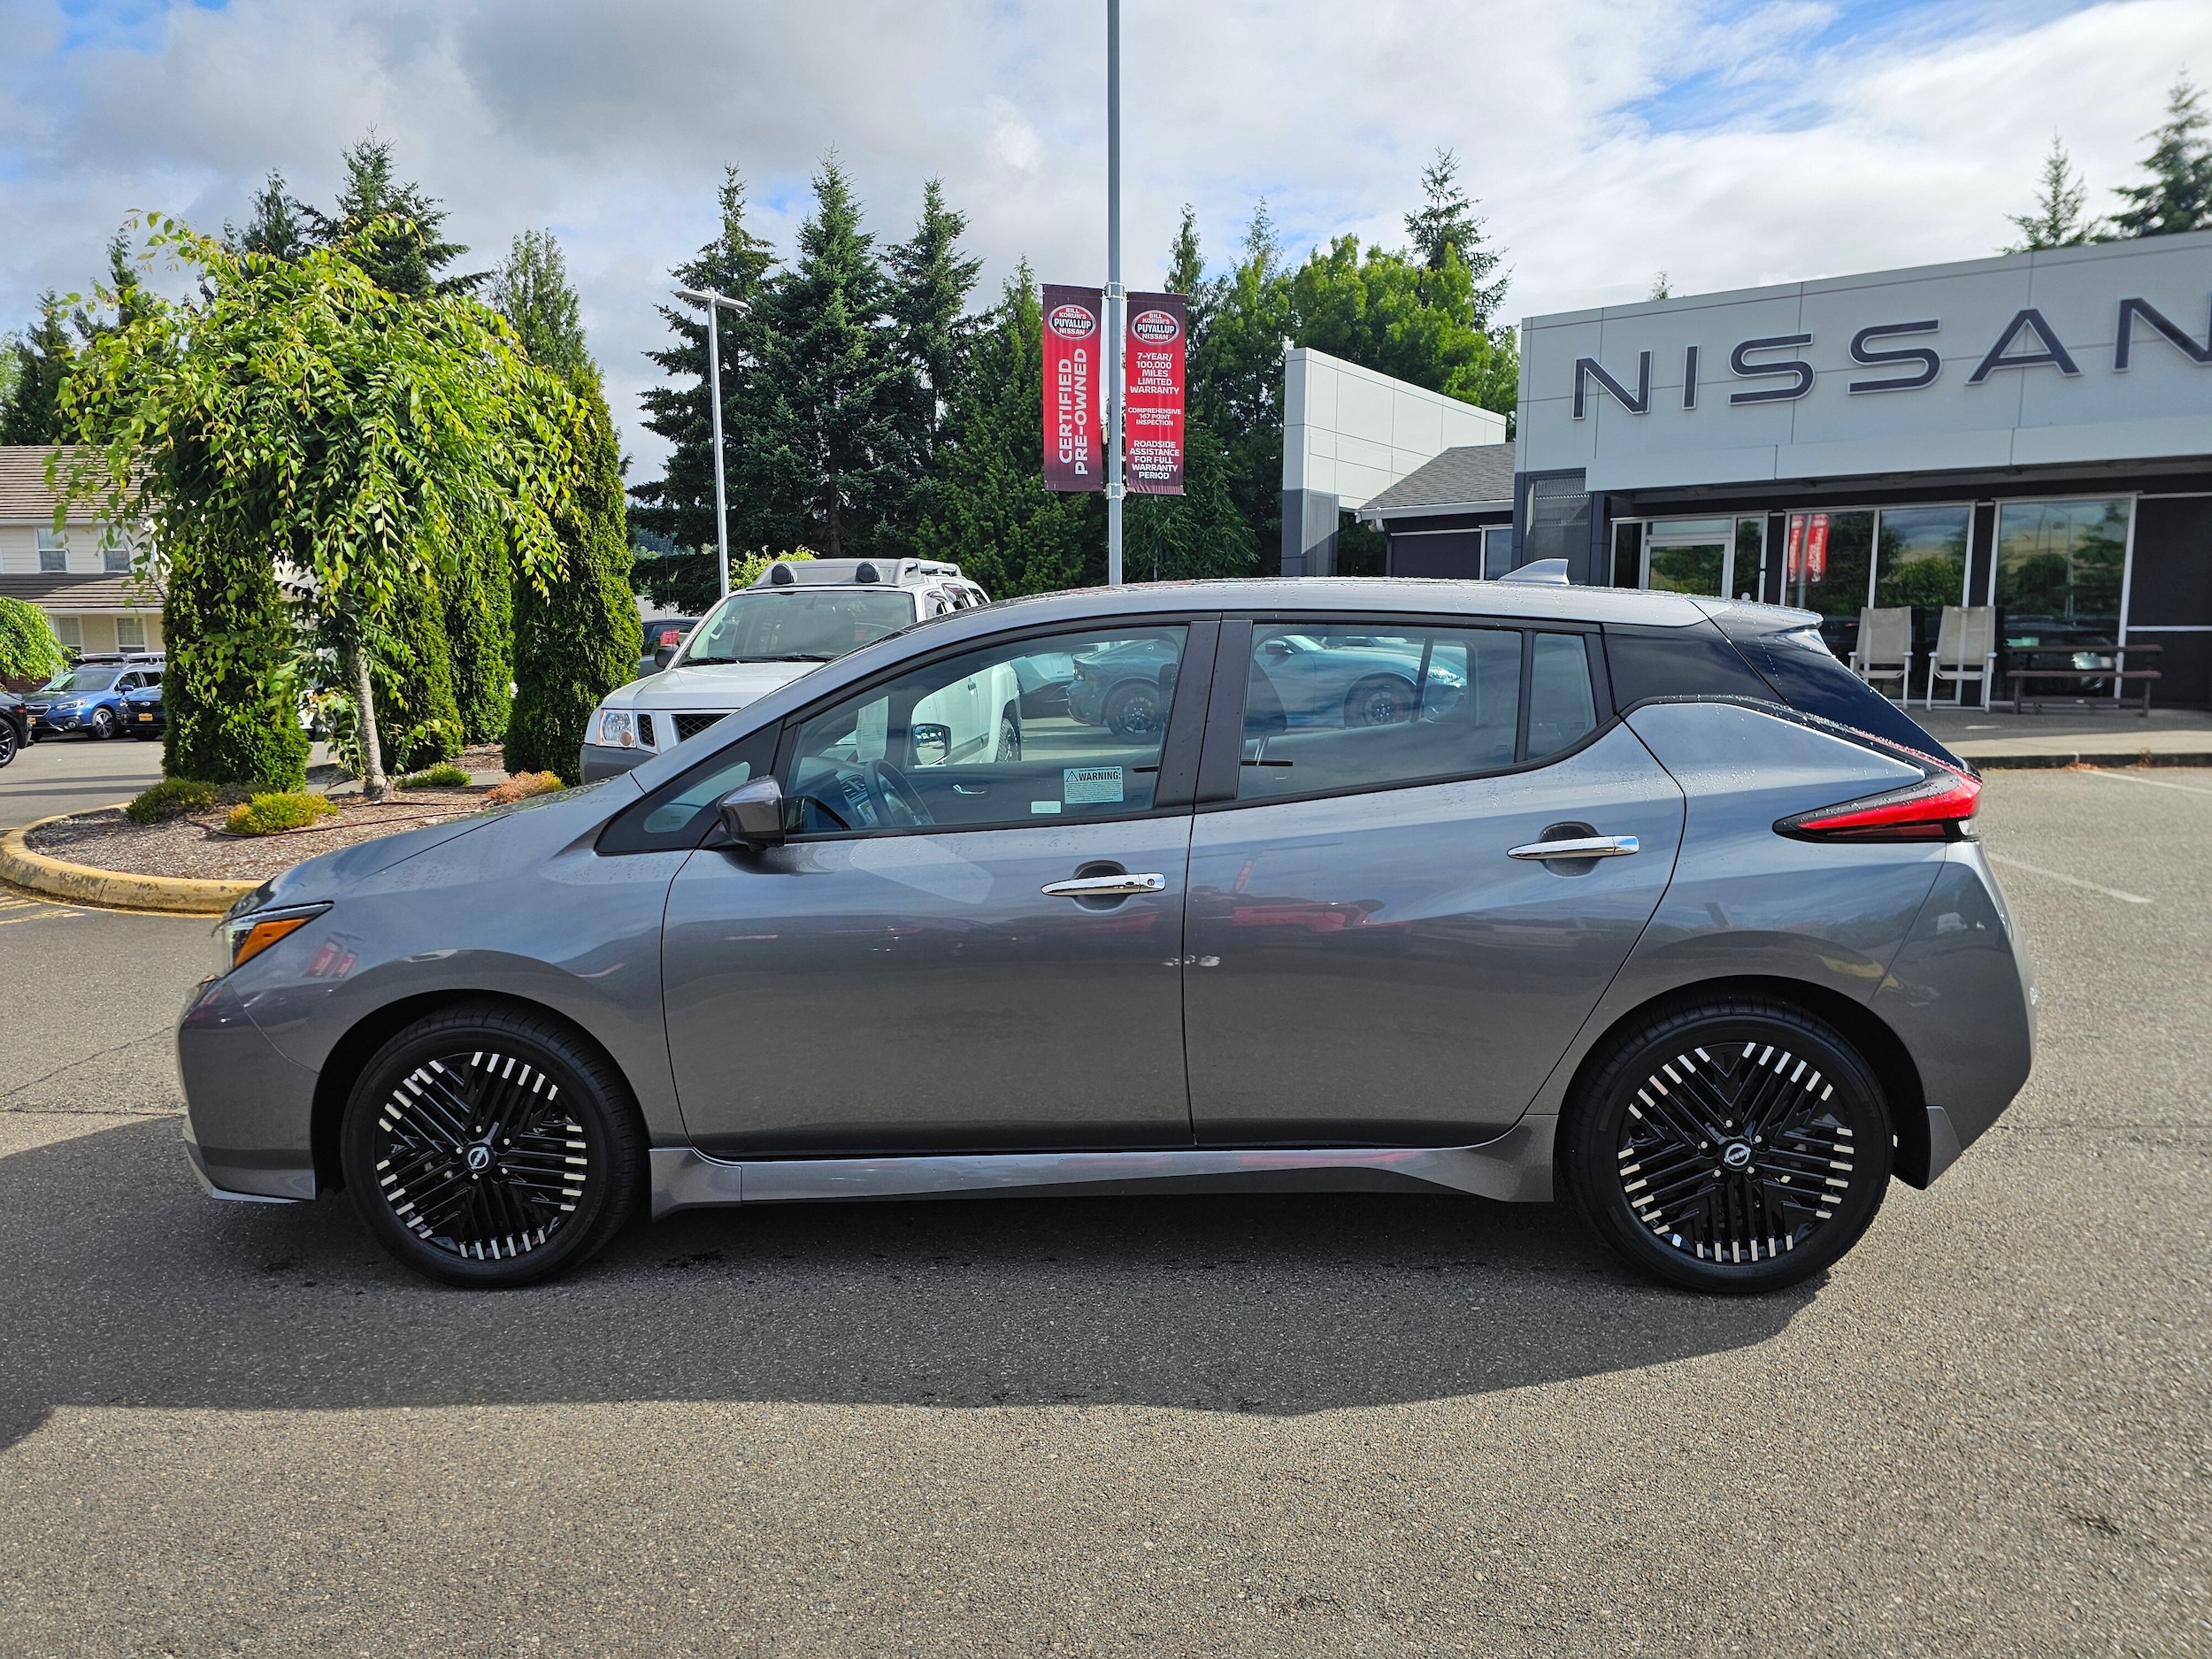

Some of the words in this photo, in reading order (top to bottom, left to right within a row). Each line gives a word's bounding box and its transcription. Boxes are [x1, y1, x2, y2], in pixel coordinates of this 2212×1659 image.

[1054, 318, 1091, 329] PUYALLUP
[1137, 323, 1175, 334] PUYALLUP
[1137, 352, 1173, 361] 7-YEAR/
[1572, 290, 2212, 420] NISSAN
[1136, 361, 1172, 370] 100,000
[1137, 377, 1172, 386] LIMITED
[1129, 386, 1179, 395] WARRANTY
[1058, 358, 1072, 464] CERTIFIED
[1074, 348, 1088, 475] PRE-OWNED
[1133, 440, 1176, 449] ROADSIDE
[1129, 448, 1180, 457] ASSISTANCE
[1131, 463, 1179, 472] WARRANTY
[1138, 471, 1170, 480] PERIOD
[1079, 771, 1121, 781] WARNING:
